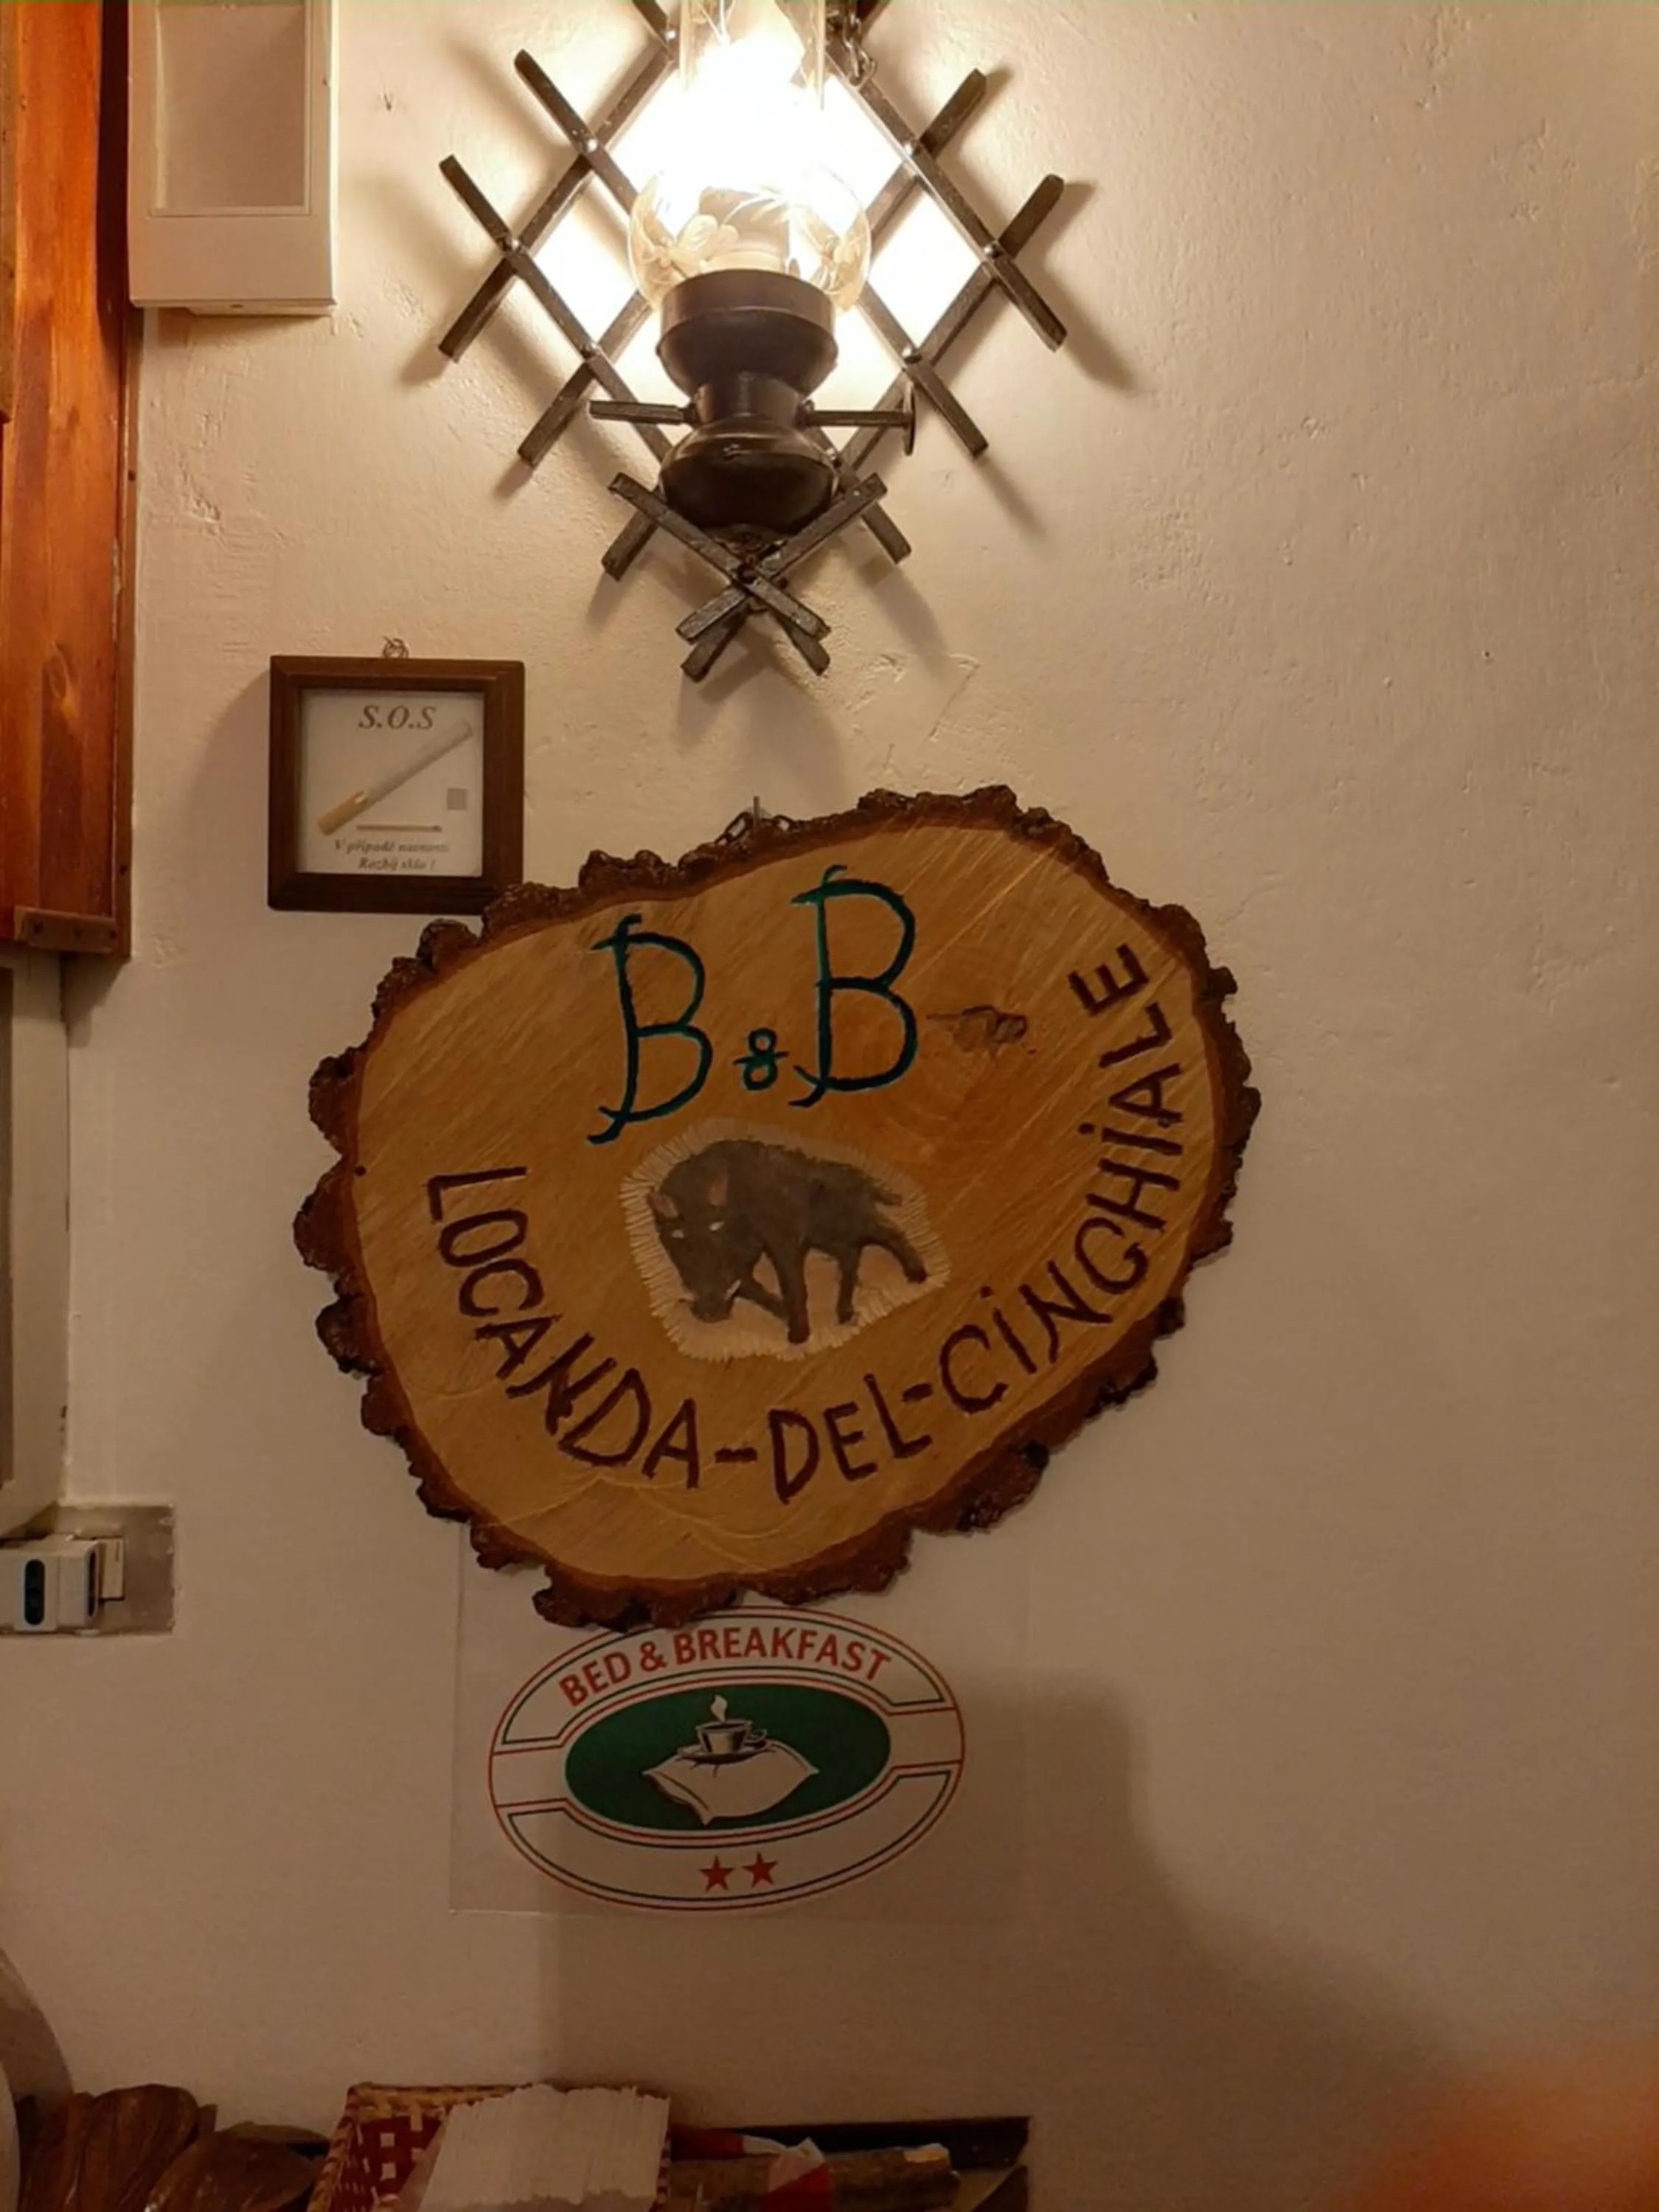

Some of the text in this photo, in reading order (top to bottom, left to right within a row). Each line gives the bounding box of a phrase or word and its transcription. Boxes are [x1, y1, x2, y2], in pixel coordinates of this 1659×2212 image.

[358, 705, 437, 730] S.O.S
[559, 1626, 892, 1707] BED & BREAKFAST
